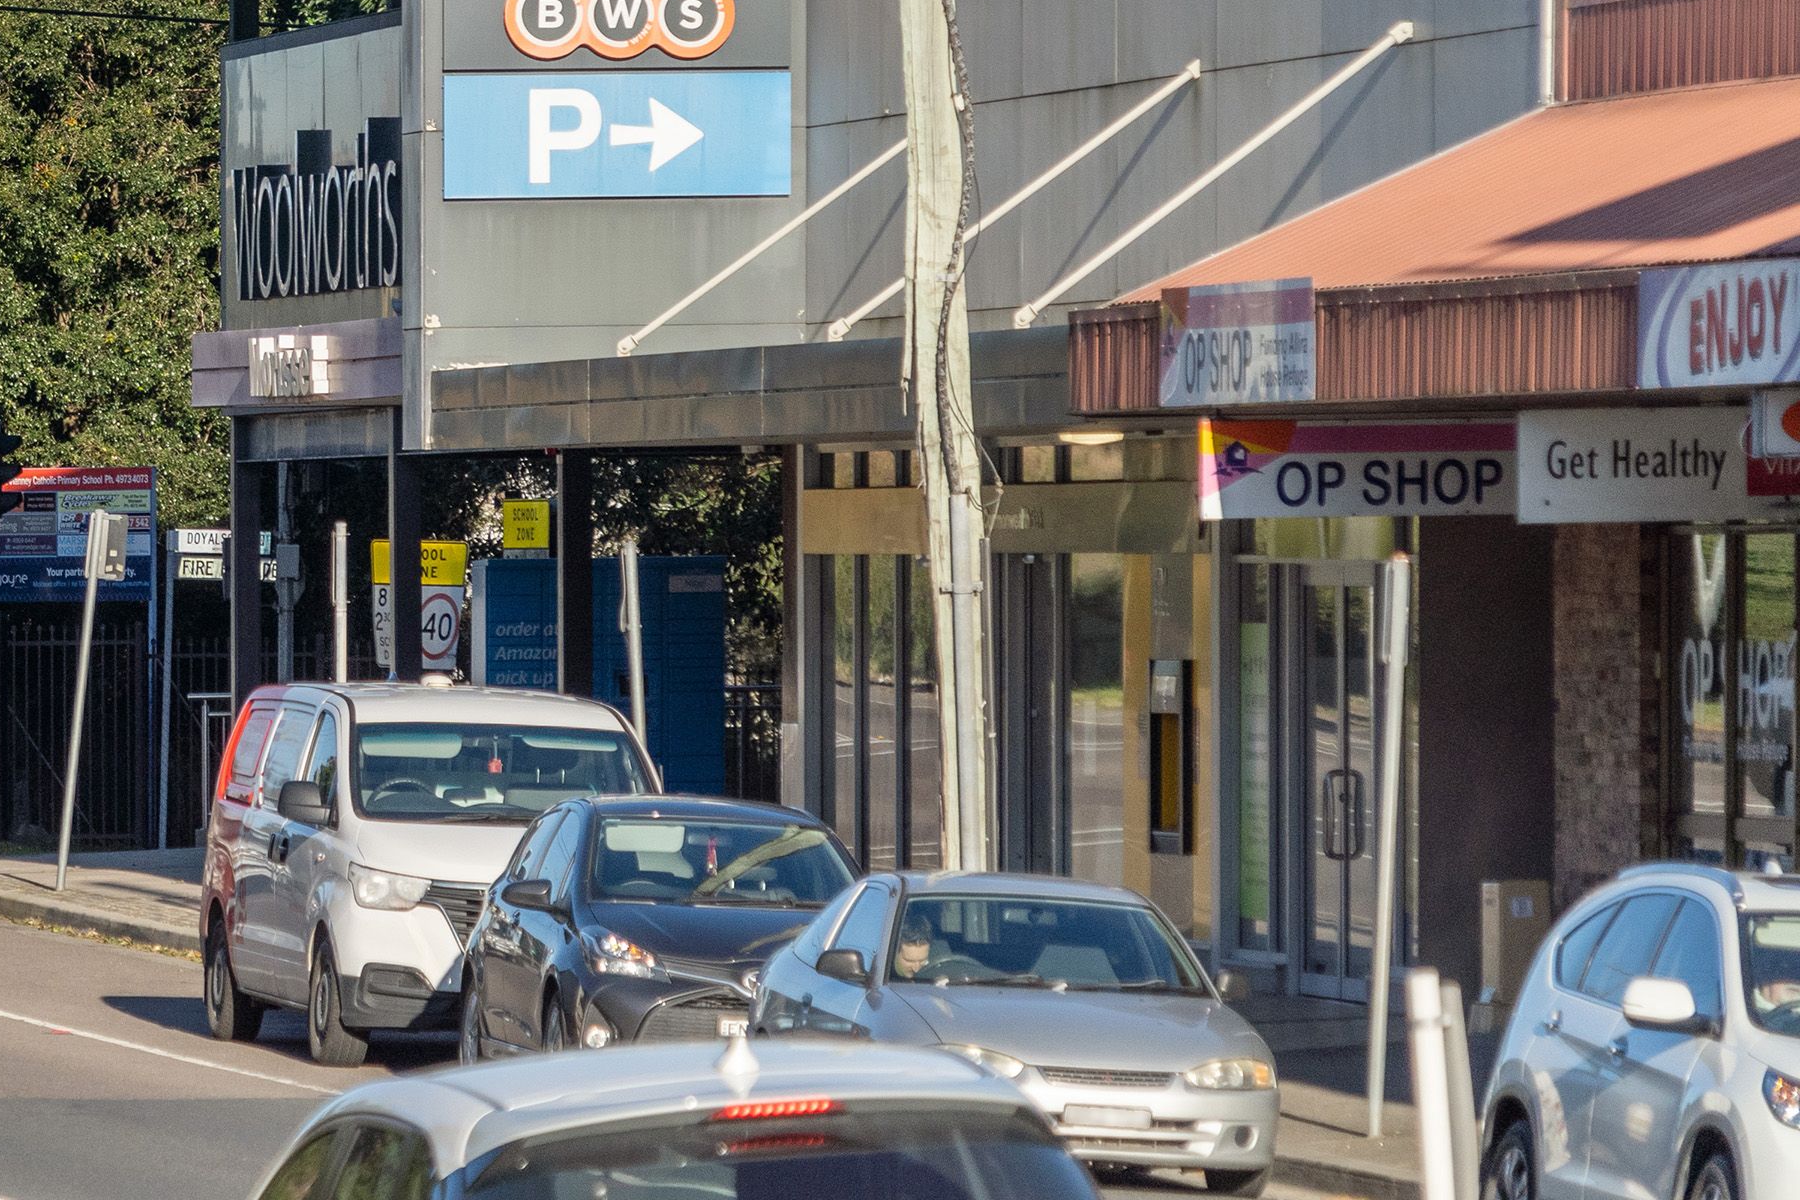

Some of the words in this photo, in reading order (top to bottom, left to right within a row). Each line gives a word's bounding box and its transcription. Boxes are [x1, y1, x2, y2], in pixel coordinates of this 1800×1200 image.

[529, 88, 603, 184] P
[231, 117, 399, 301] Woolworths
[1690, 271, 1788, 376] ENJOY
[1185, 333, 1206, 394] OP
[1210, 330, 1253, 393] SHOP
[1547, 440, 1599, 480] Get
[1612, 438, 1727, 490] Healthy
[33, 475, 57, 485] Catholic
[57, 475, 80, 486] Primary
[81, 474, 103, 485] School
[1277, 460, 1344, 507] OP
[1362, 458, 1502, 504] SHOP
[64, 494, 118, 502] Breakaway
[512, 508, 539, 521] SCHOOL
[516, 527, 535, 541] ZONE
[46, 567, 63, 577] Your
[64, 568, 86, 580] partn
[182, 559, 214, 576] FIRE
[422, 612, 453, 642] 40
[495, 621, 538, 637] order
[533, 673, 554, 688] up
